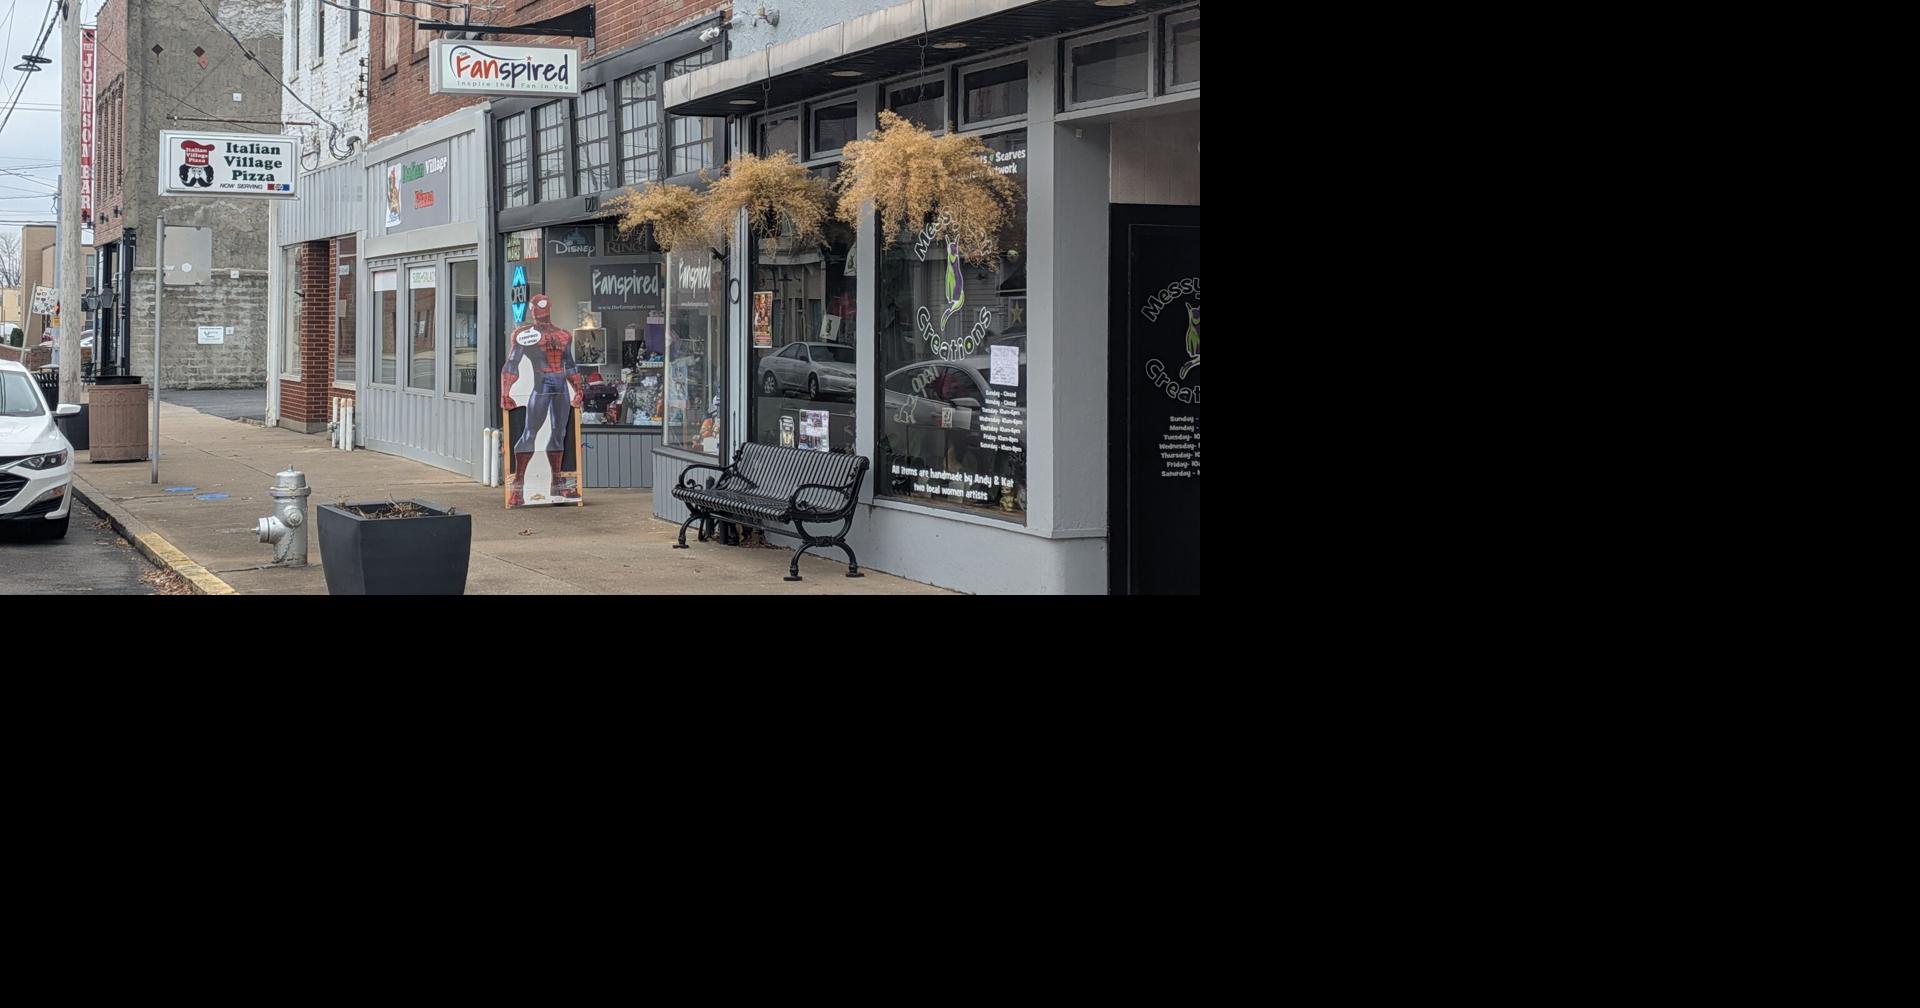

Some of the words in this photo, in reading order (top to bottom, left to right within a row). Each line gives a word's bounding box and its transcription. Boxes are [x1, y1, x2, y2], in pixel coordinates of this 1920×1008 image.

[456, 53, 569, 89] Fanspired
[457, 80, 491, 88] Inspire
[82, 53, 93, 158] JOHNSON
[226, 142, 281, 155] Italian
[995, 149, 1026, 162] Scarves
[224, 156, 283, 170] Village
[425, 156, 447, 174] Village
[231, 170, 275, 181] Pizza
[549, 240, 595, 257] Disney
[592, 264, 658, 303] Fanspired
[917, 306, 992, 361] Creations
[985, 390, 1000, 398] Sunday
[985, 399, 1000, 407] Monday
[901, 467, 918, 476] items
[919, 470, 929, 478] are
[930, 469, 963, 482] handmade
[964, 473, 973, 485] by
[974, 474, 992, 488] Andy
[993, 477, 1000, 486] &
[1001, 477, 1014, 488] Kat
[914, 483, 925, 492] two
[927, 485, 940, 494] local
[942, 487, 964, 497] women
[966, 490, 988, 501] artists
